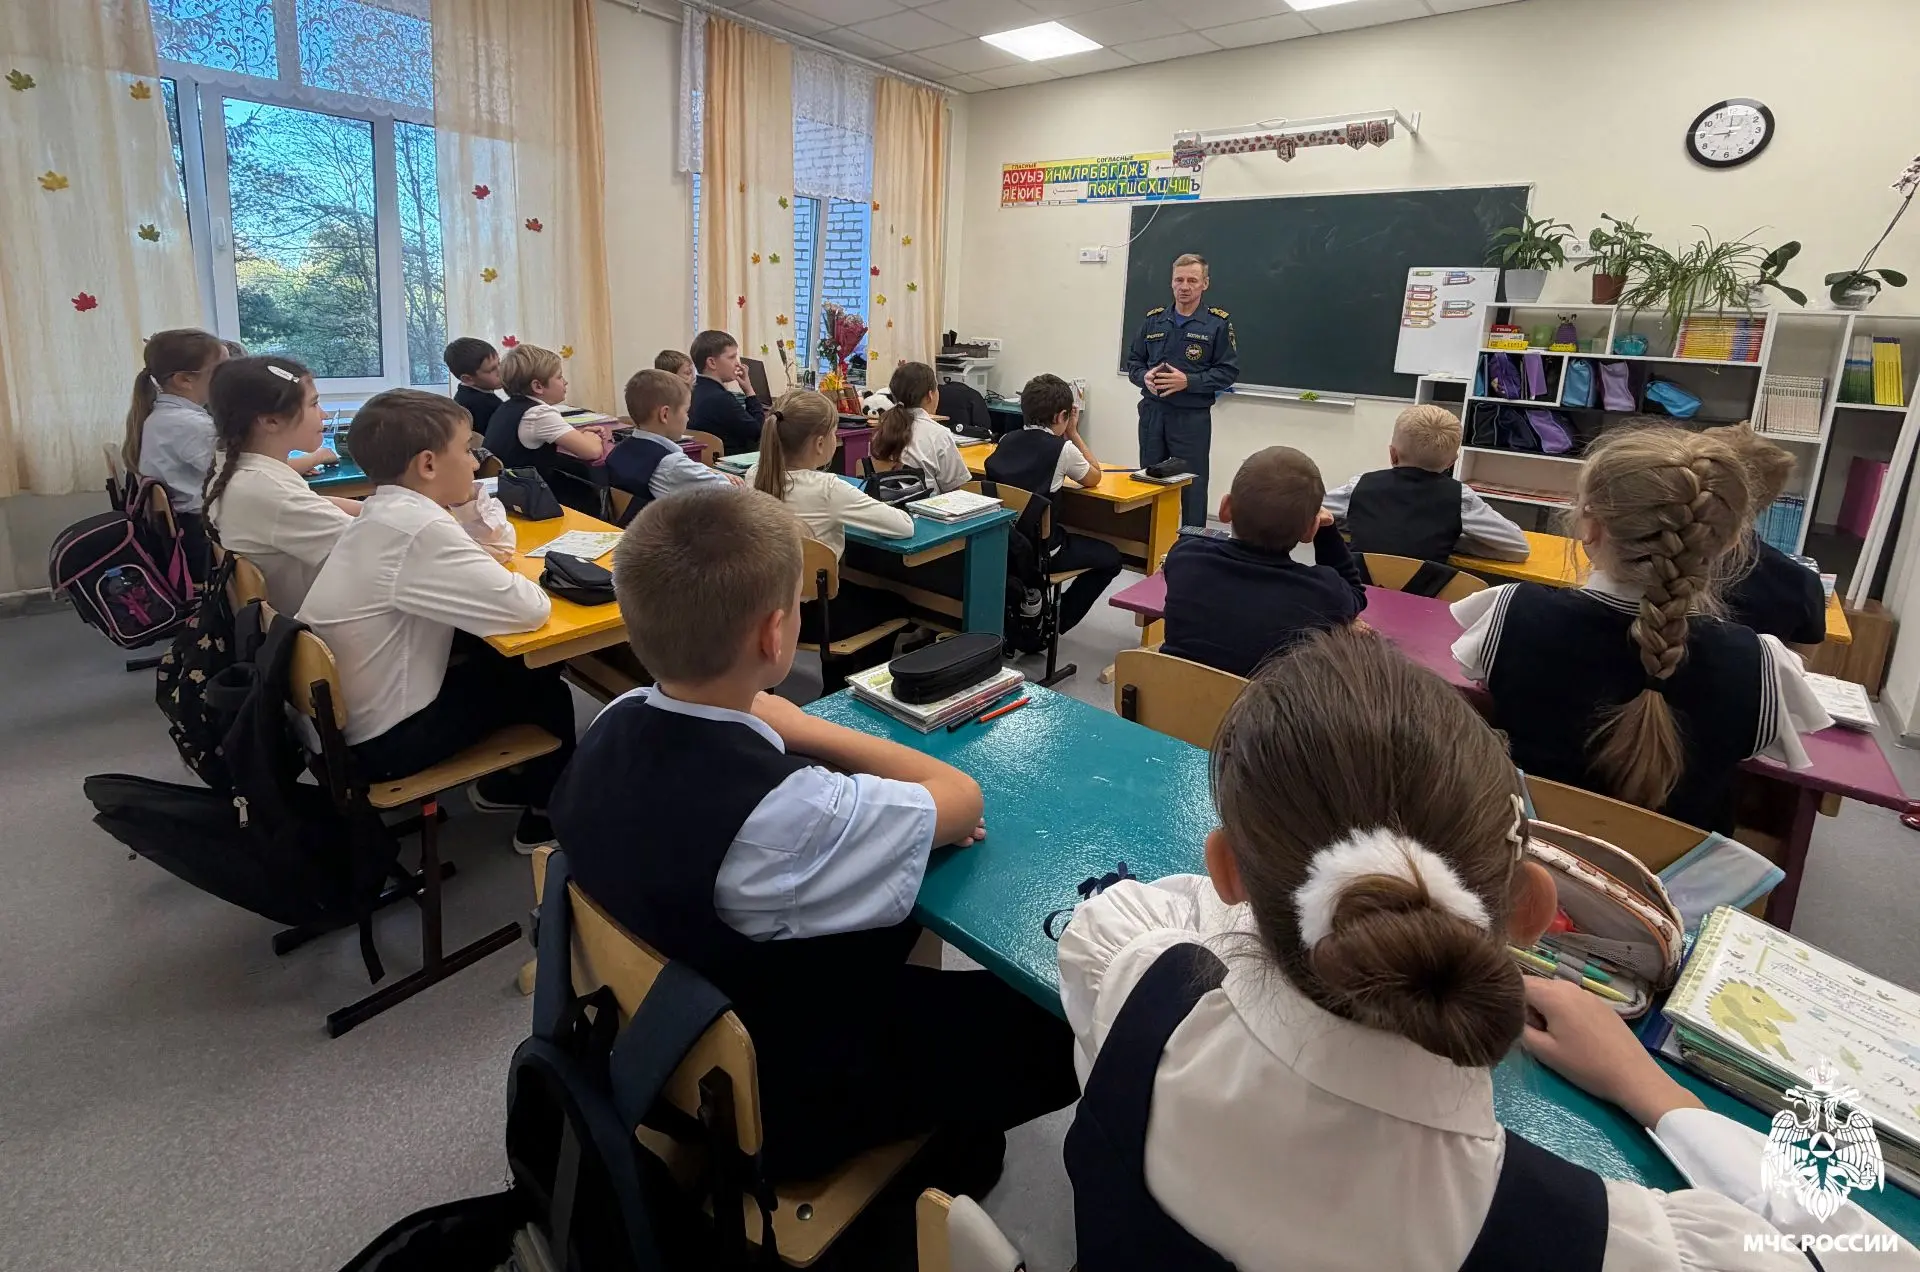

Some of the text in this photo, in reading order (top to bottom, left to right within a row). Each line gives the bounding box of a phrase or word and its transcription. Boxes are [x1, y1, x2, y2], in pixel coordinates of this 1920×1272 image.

[1704, 120, 1713, 128] 10
[1755, 126, 1761, 134] 3
[1702, 142, 1708, 150] 8
[1748, 138, 1755, 146] 4
[1710, 149, 1716, 157] 7
[1723, 151, 1730, 159] 6
[1737, 147, 1744, 155] 5
[1096, 155, 1134, 164] СОГЛАСНЫЕ
[1011, 162, 1037, 170] ГЛАСНЫЕ
